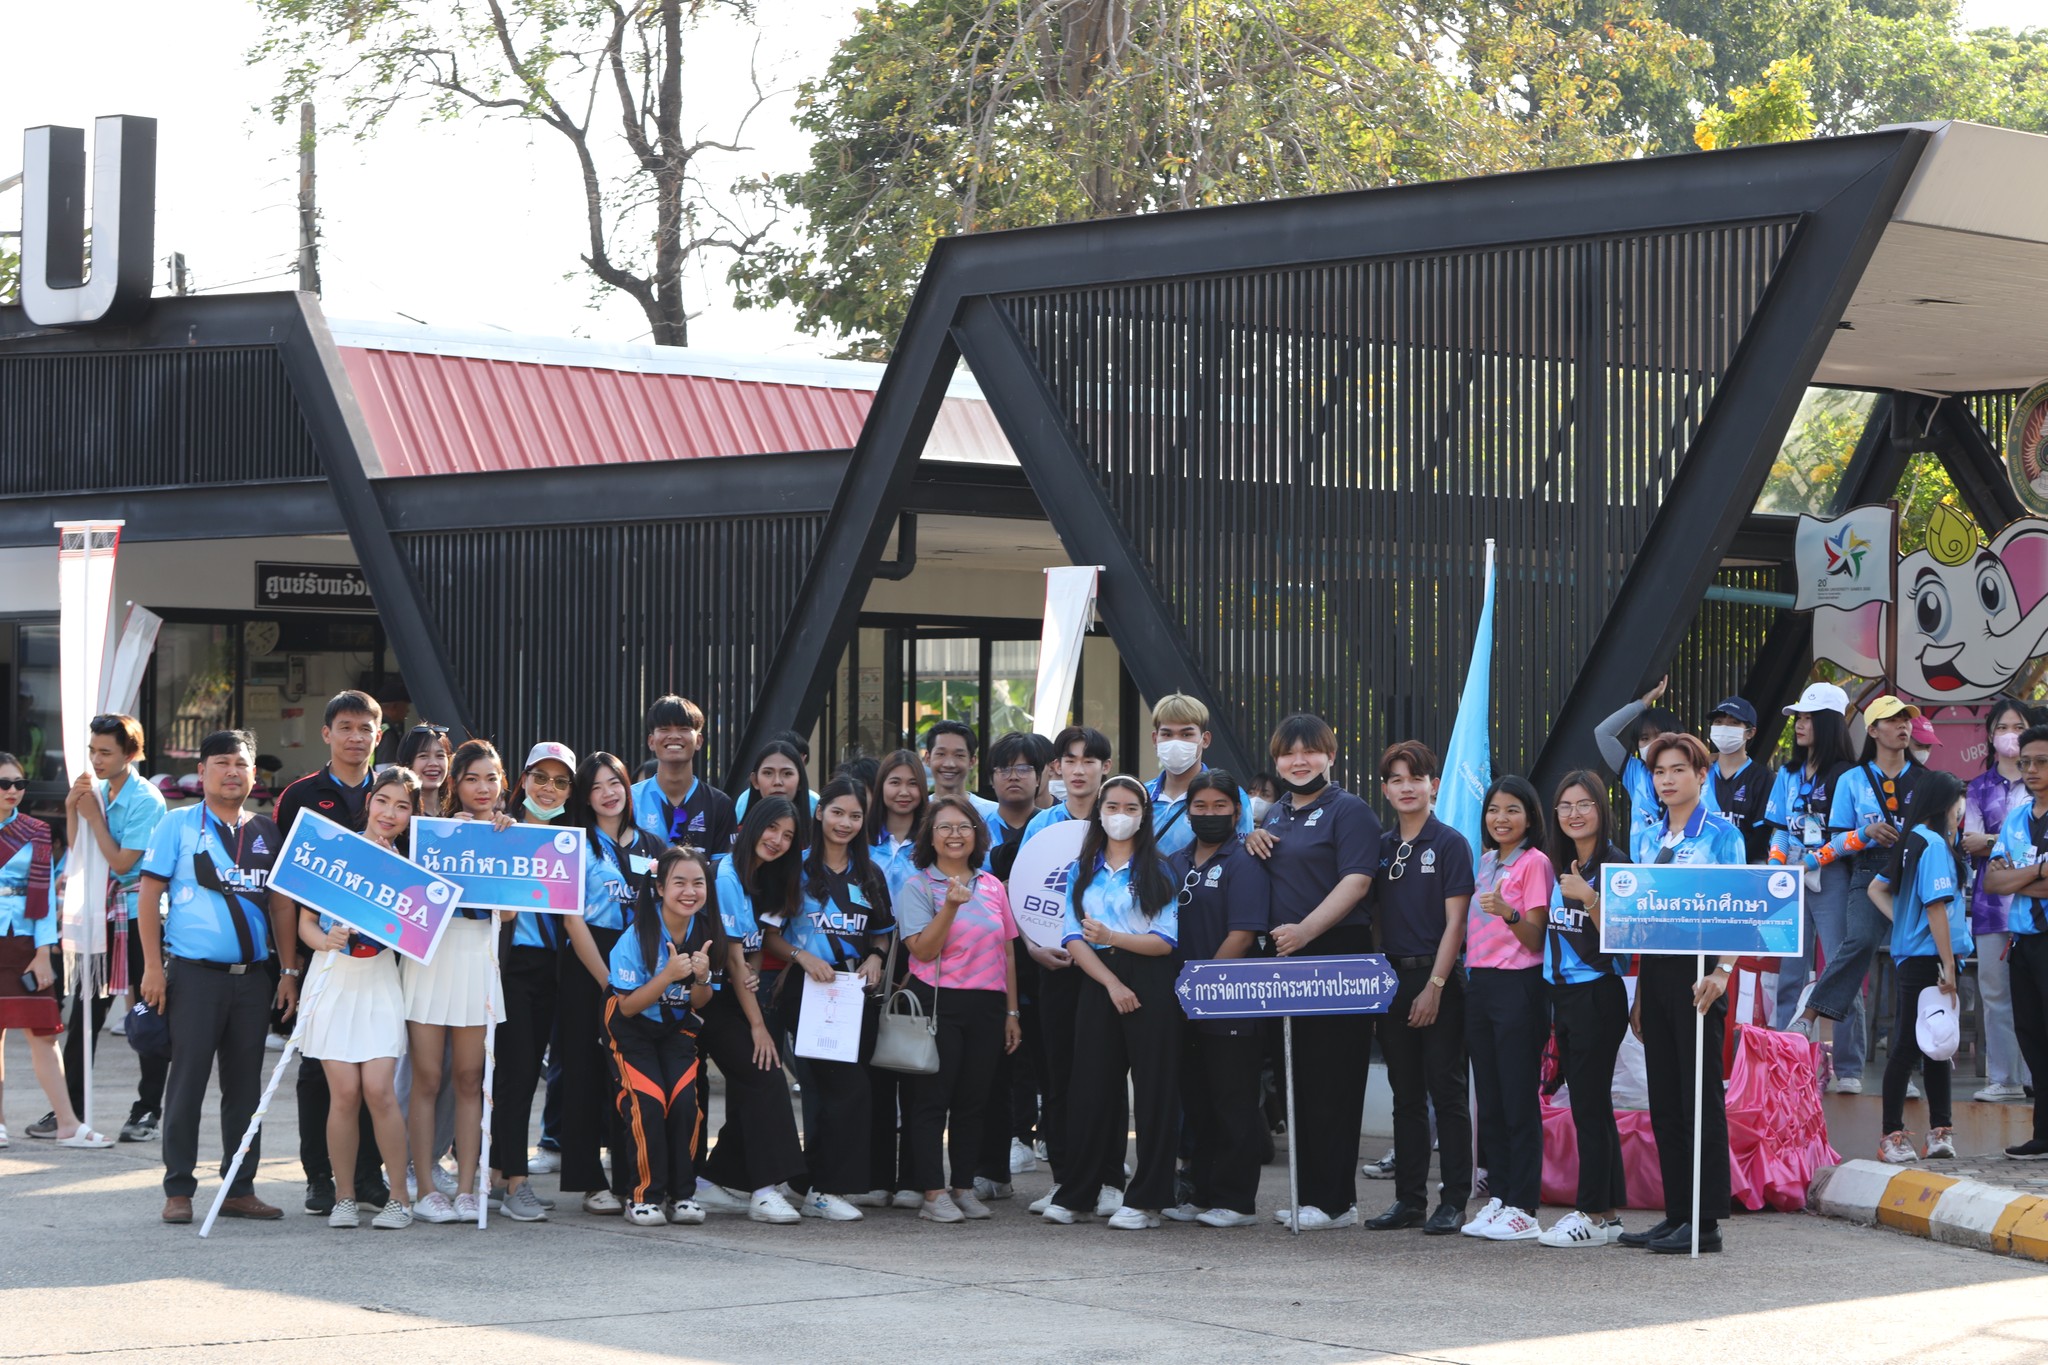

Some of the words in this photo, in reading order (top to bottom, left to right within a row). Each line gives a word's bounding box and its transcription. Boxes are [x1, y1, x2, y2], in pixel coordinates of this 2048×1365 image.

[1023, 895, 1066, 918] BB
[1637, 889, 1768, 912] สโมสรนักศึกษา
[1020, 914, 1059, 930] FACULTY
[1195, 968, 1381, 1009] การจัดการธุรกิจระหว่างประเทศ
